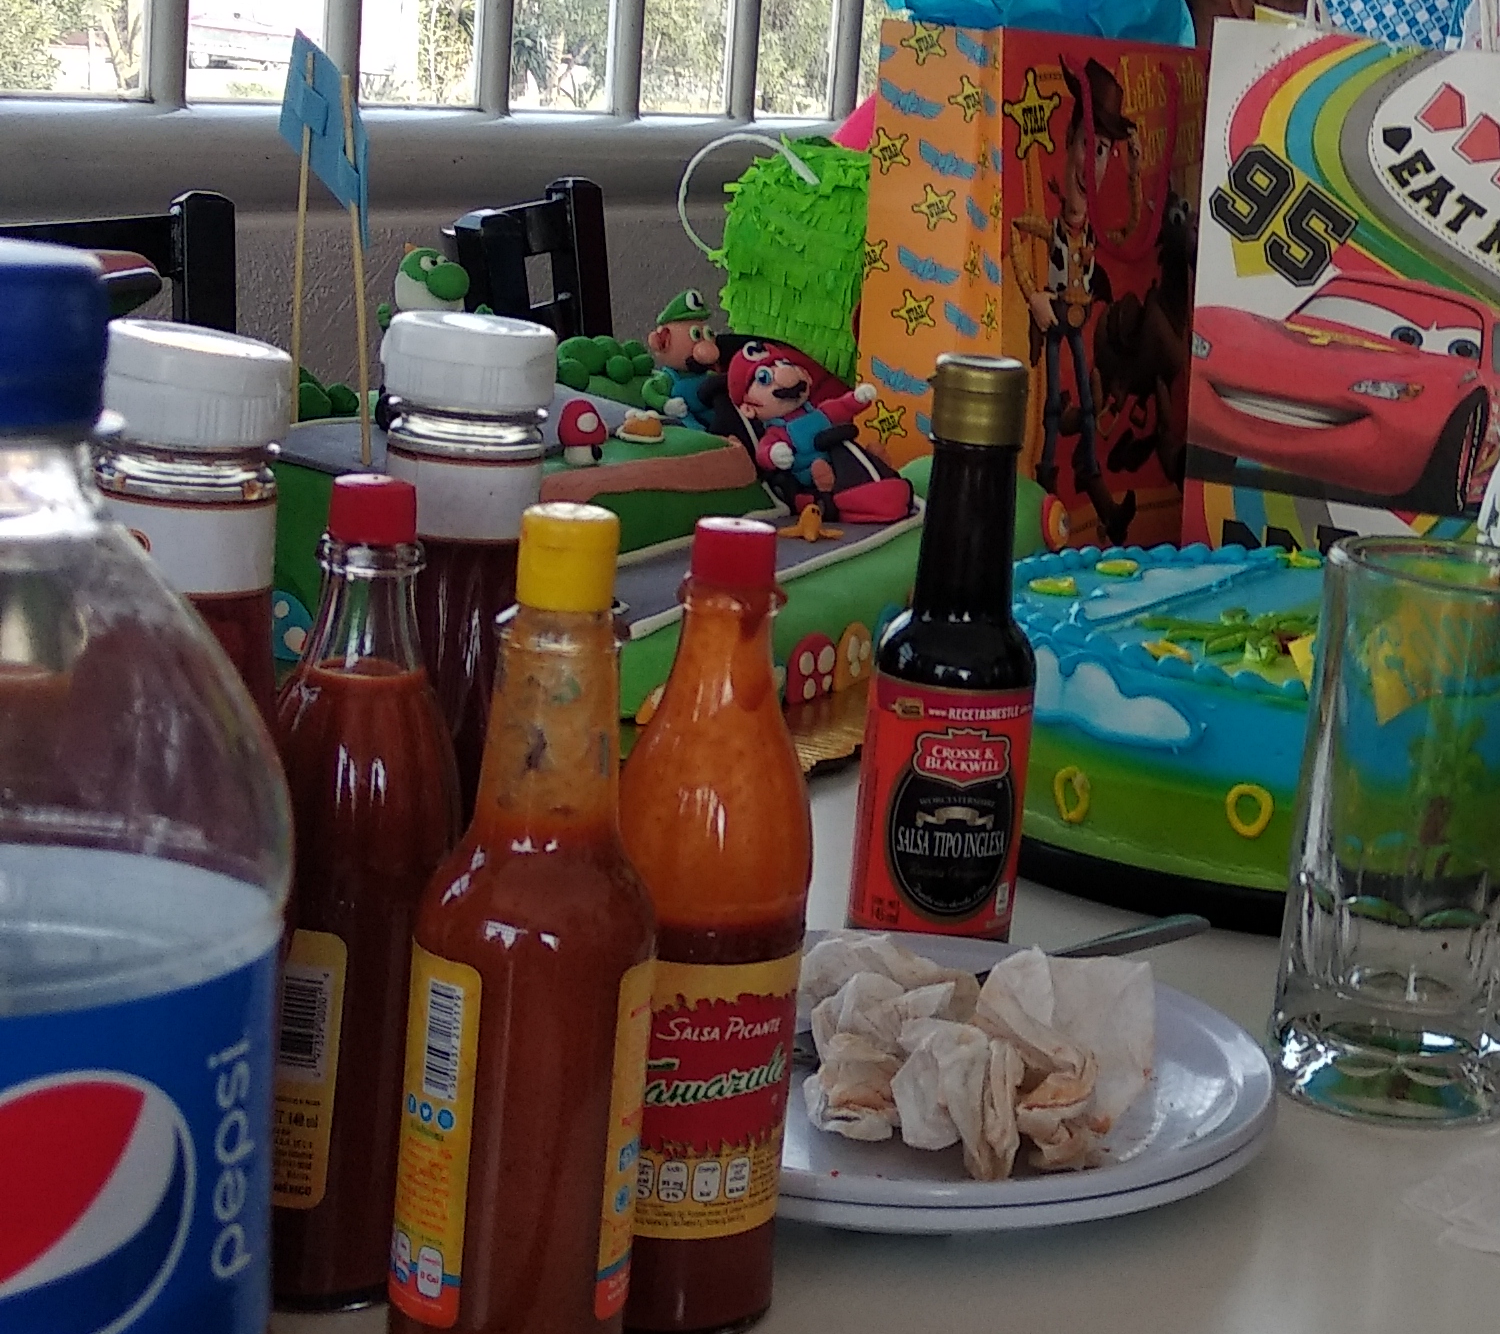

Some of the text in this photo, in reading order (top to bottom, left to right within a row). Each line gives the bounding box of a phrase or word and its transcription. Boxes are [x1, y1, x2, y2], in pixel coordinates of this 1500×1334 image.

[1022, 104, 1047, 137] STAR
[1385, 149, 1488, 233] EAT
[1209, 143, 1359, 288] 95
[924, 755, 999, 774] BLACKWELL
[931, 744, 995, 759] CROSSE &
[896, 825, 1005, 859] SALSA TIPO INGLESA
[656, 1017, 720, 1041] SALSA
[208, 1033, 256, 1279] pepsi
